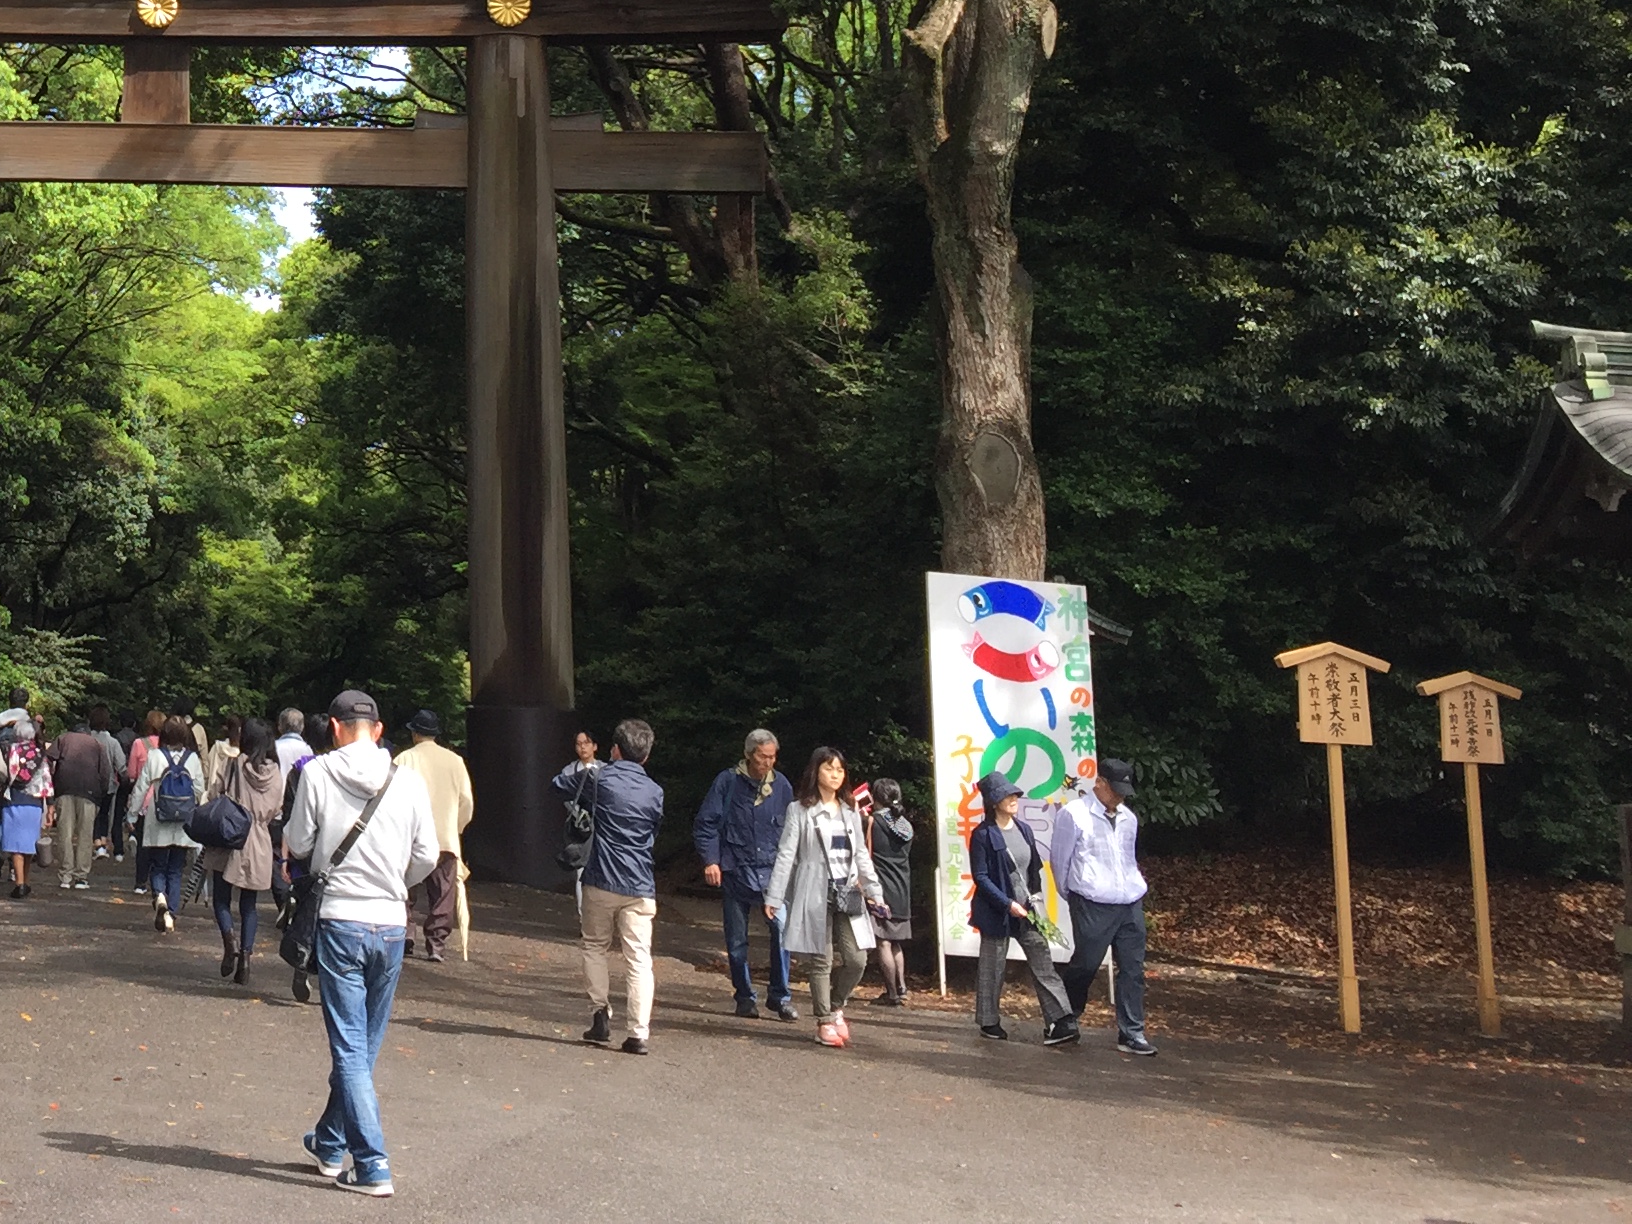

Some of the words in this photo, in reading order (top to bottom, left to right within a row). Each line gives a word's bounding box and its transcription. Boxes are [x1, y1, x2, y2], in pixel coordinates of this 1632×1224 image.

[1057, 587, 1098, 780] 神宮の森の
[1307, 672, 1322, 725] 午前十時
[1325, 662, 1347, 738] 崇敬者大祭
[1347, 672, 1361, 722] 五月三日
[1448, 702, 1460, 748] 午前十一時
[1482, 698, 1494, 737] 五月一日
